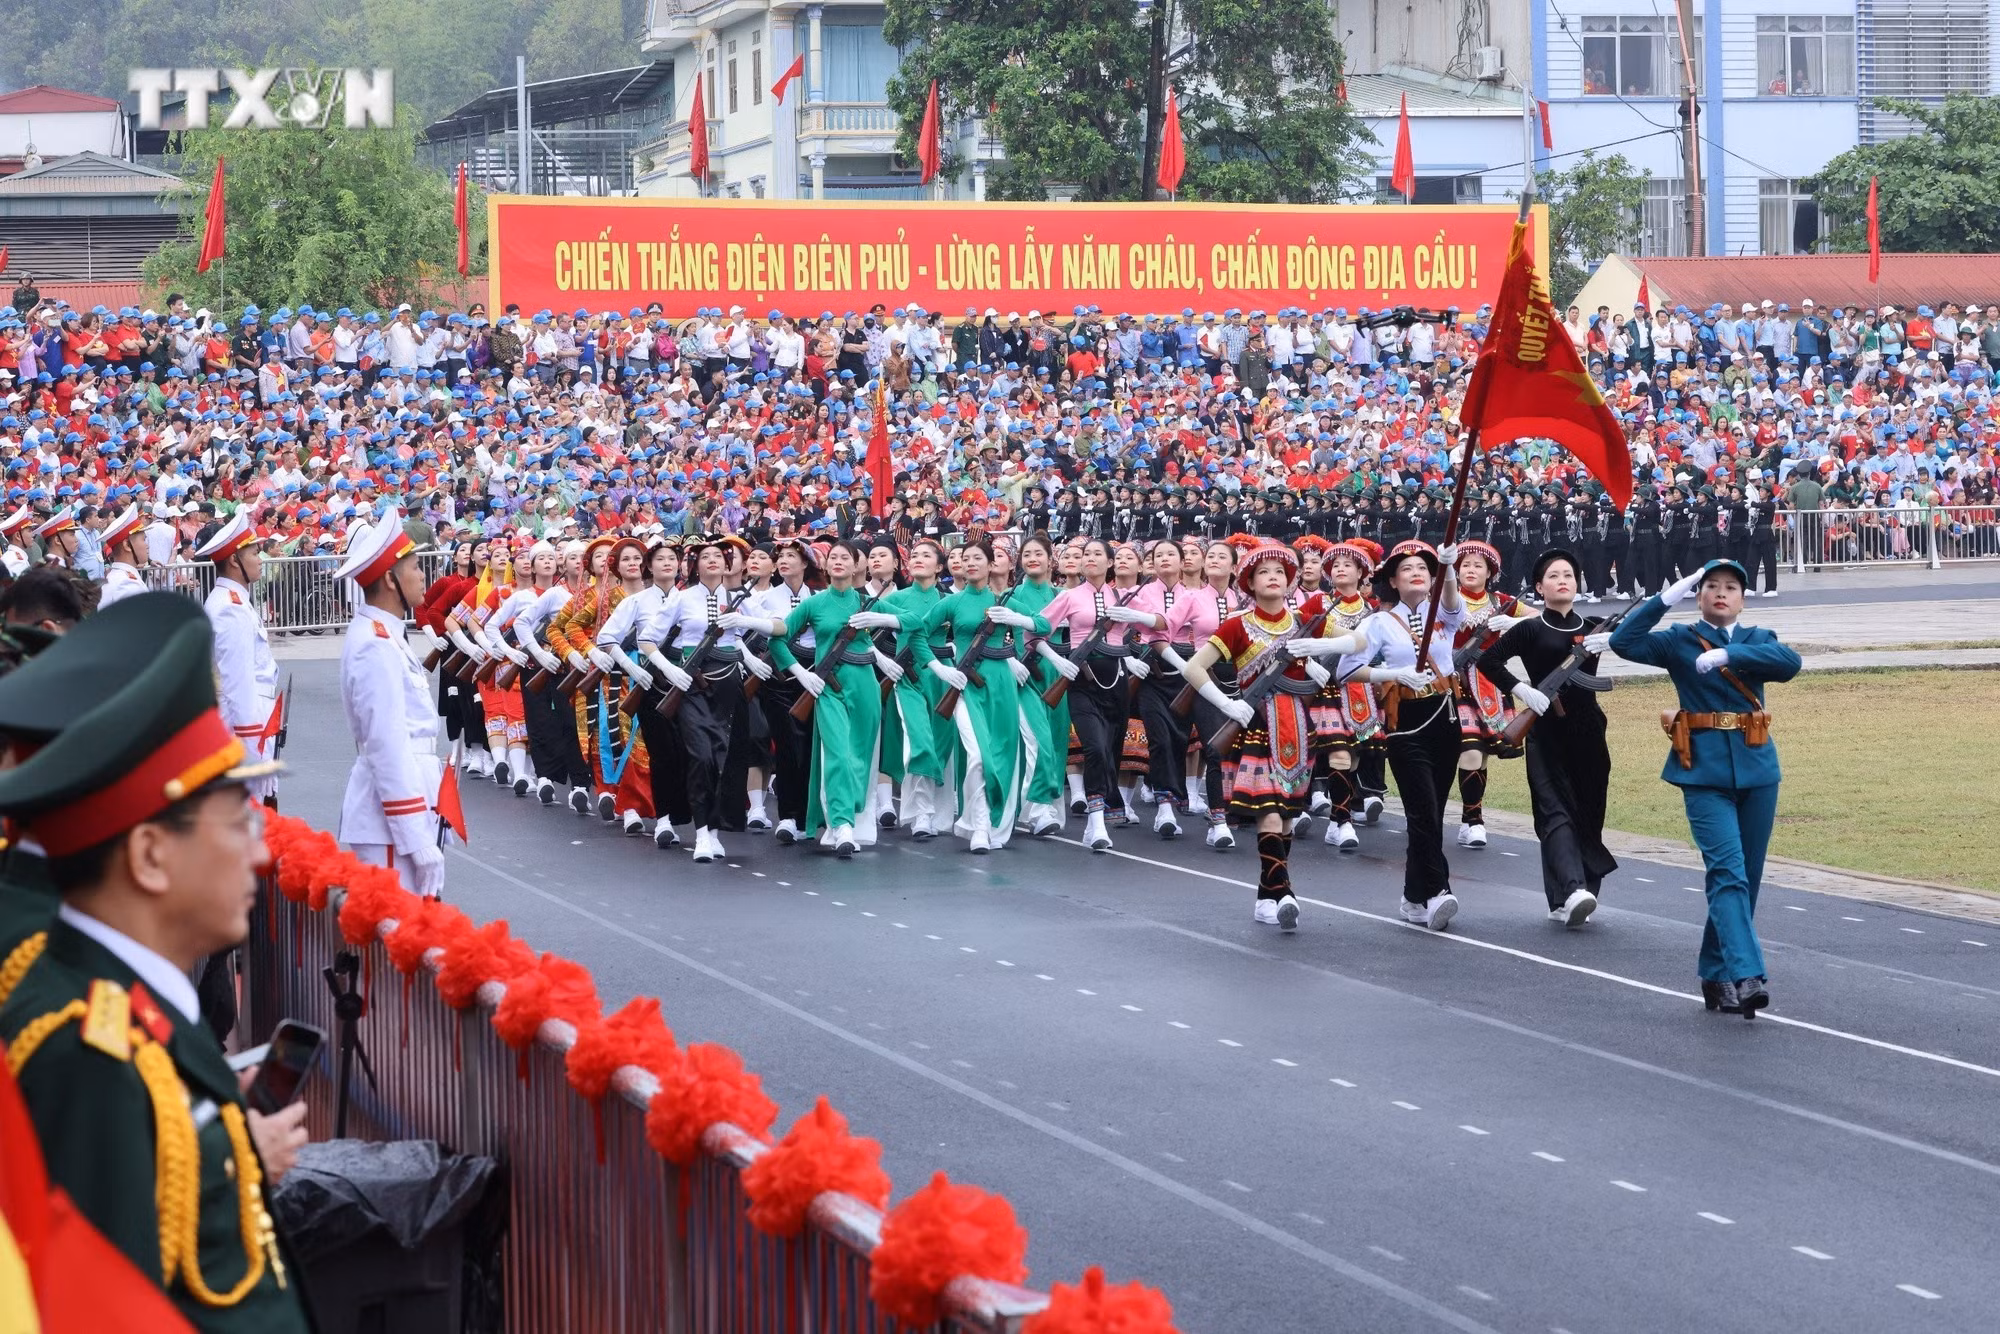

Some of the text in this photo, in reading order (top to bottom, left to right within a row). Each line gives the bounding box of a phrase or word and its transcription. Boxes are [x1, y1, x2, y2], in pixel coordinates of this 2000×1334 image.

[555, 225, 630, 291] CHIẾN
[636, 223, 720, 292] THẮNG
[726, 232, 786, 301] ĐIỆN
[793, 232, 853, 292] BIÊN
[859, 226, 911, 291] PHỦ
[935, 233, 1002, 291] LỪNG
[1008, 225, 1054, 290] LẪY
[1061, 233, 1121, 290] NĂM
[1128, 233, 1204, 295] CHÂU,
[1211, 227, 1280, 290] CHẤN
[1285, 235, 1356, 301] ĐỘNG
[1362, 244, 1407, 301] ĐỊA
[1516, 304, 1550, 362] QUYẾT
